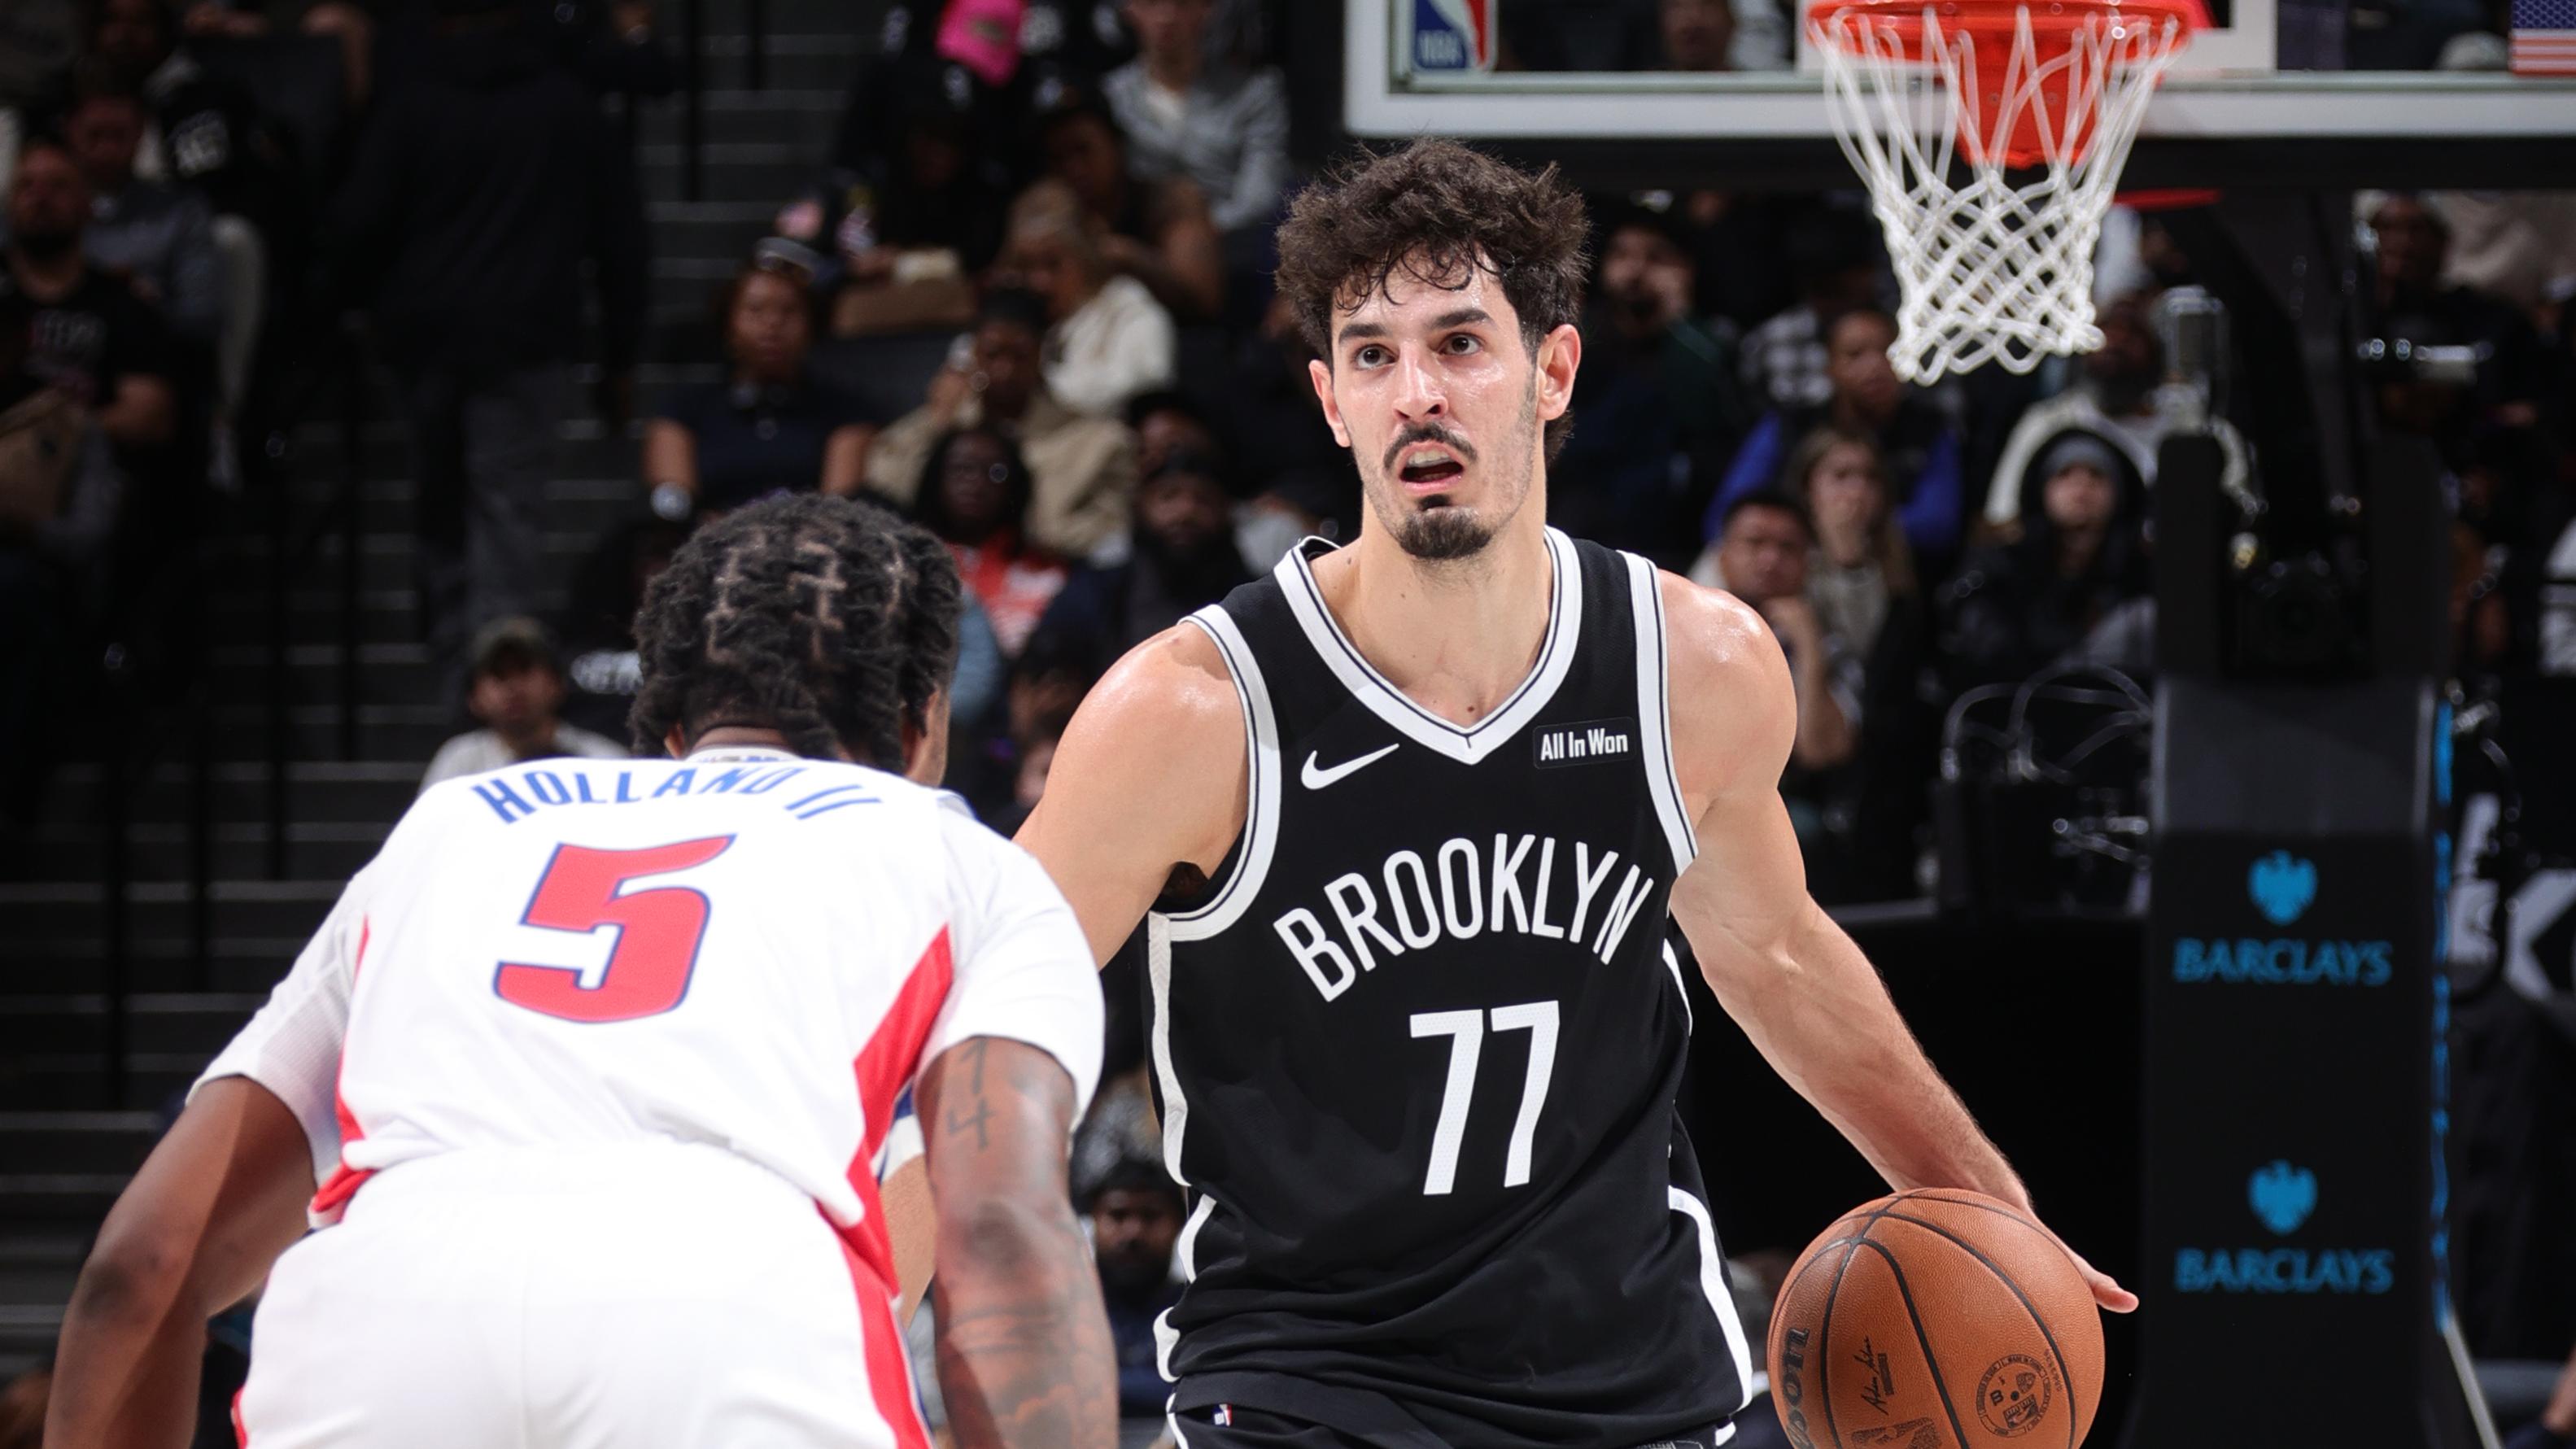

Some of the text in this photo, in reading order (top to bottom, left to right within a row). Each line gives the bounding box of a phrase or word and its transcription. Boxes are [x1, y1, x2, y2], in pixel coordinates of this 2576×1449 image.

[1540, 727, 1629, 761] All In Won
[470, 767, 884, 824] HOLLAND II
[492, 833, 738, 1023] 5
[1273, 832, 1655, 1003] BROOKLYN
[2172, 938, 2393, 986] BARCLAYS
[1409, 1000, 1561, 1195] 77
[2173, 1246, 2395, 1294] BARCLAYS
